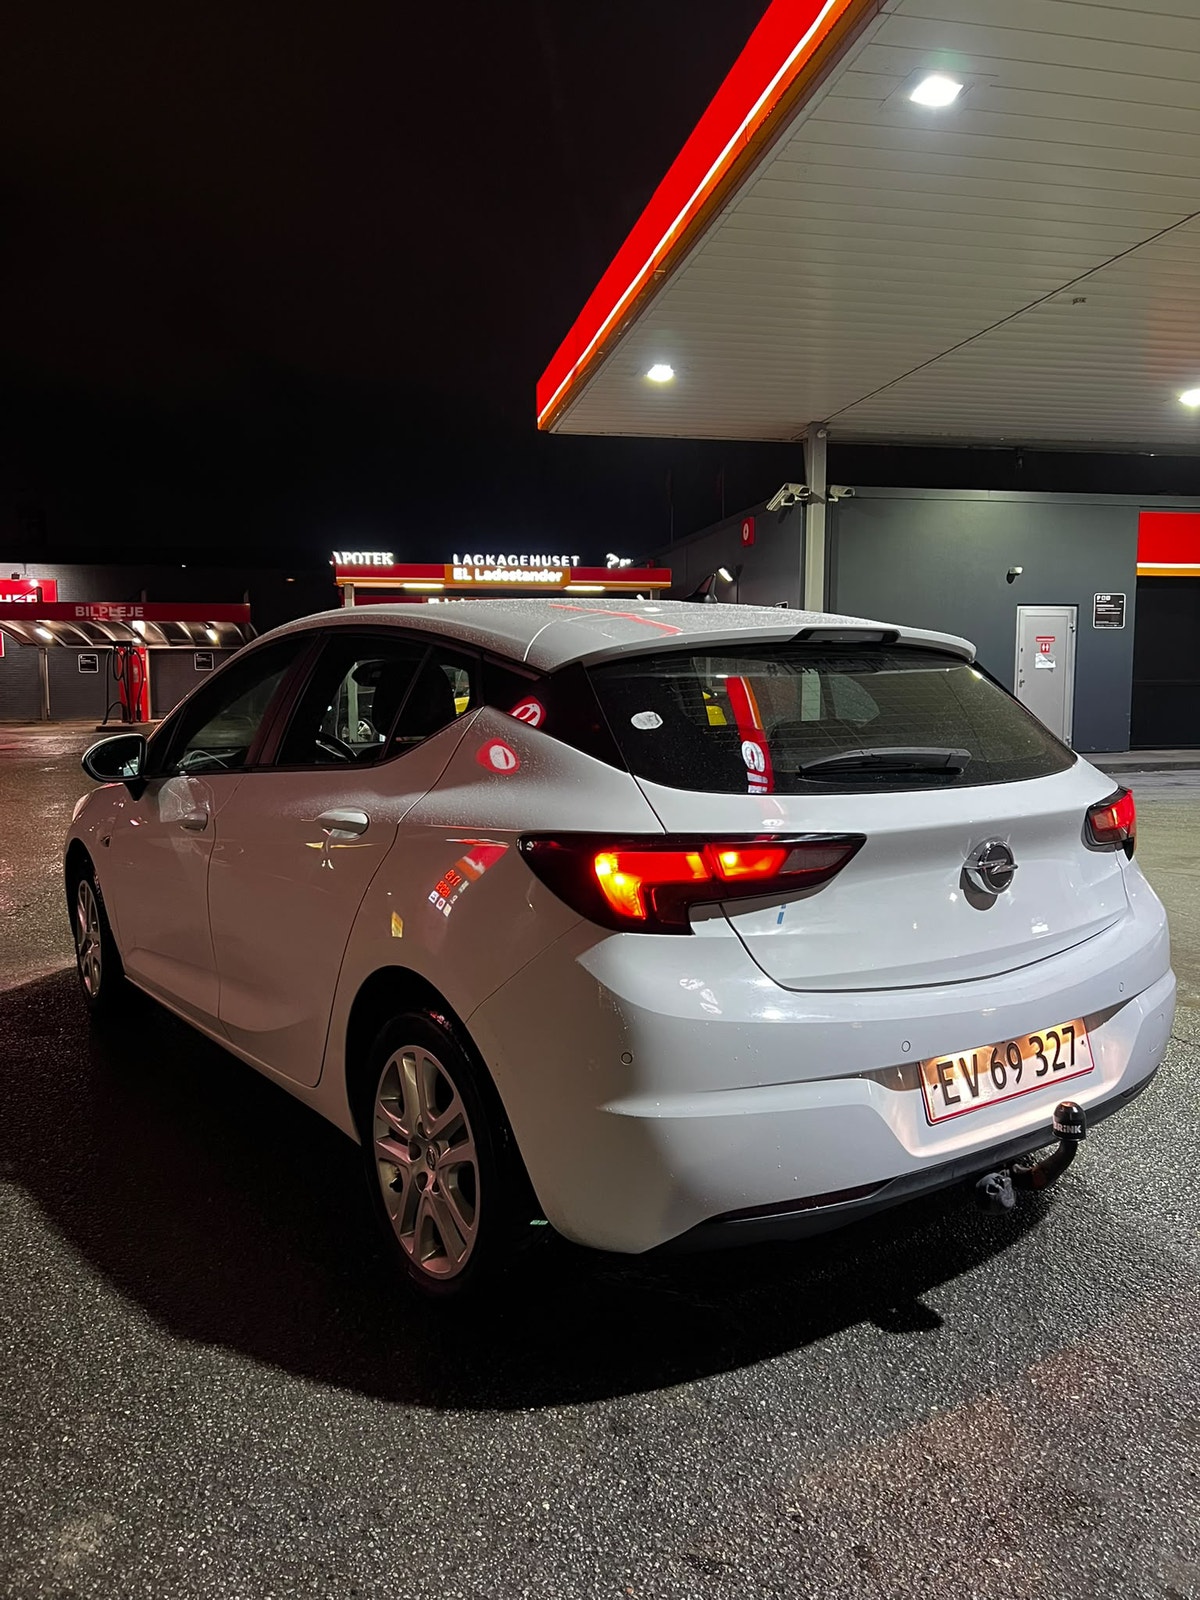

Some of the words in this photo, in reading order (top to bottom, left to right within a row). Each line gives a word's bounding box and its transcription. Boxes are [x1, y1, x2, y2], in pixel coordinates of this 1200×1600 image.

[329, 551, 394, 565] APOTEK
[452, 554, 580, 568] LAGKAGEHUSET
[474, 568, 563, 582] Ladestander
[75, 606, 144, 617] BILPLEJE
[936, 1054, 980, 1106] EV
[990, 1042, 1023, 1090] 69
[1029, 1026, 1076, 1077] 327
